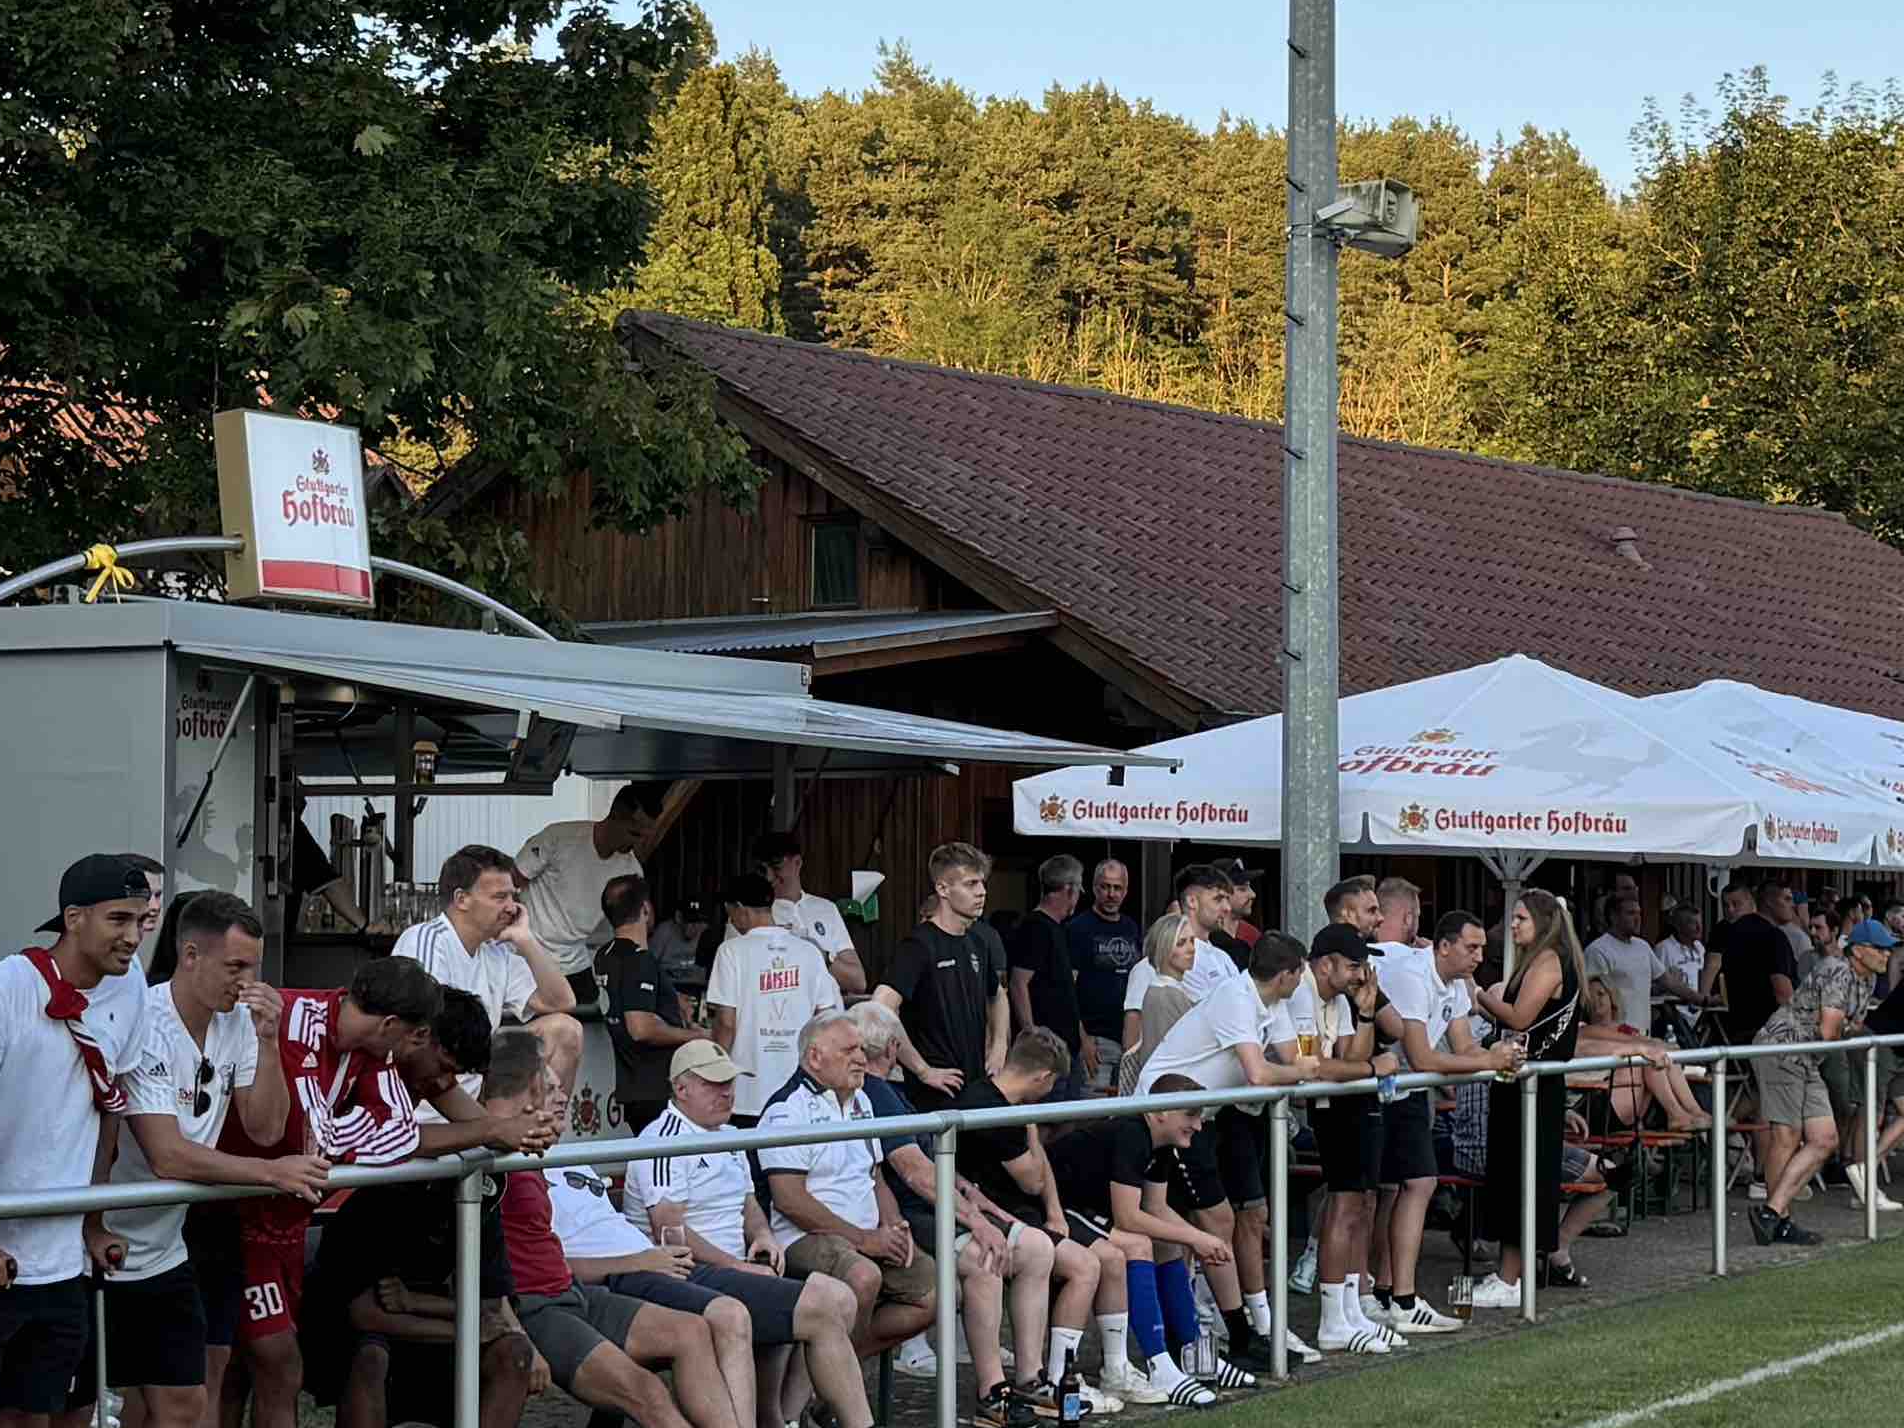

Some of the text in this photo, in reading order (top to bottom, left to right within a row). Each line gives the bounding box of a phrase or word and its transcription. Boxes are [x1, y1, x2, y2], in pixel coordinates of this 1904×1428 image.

[282, 490, 355, 527] Hofbräu
[1338, 755, 1499, 776] ofbräu
[1072, 799, 1249, 824] Stuttgarter Hofbräu
[1435, 809, 1627, 835] Stuttgarter Hofbräu
[245, 1282, 284, 1322] 30
